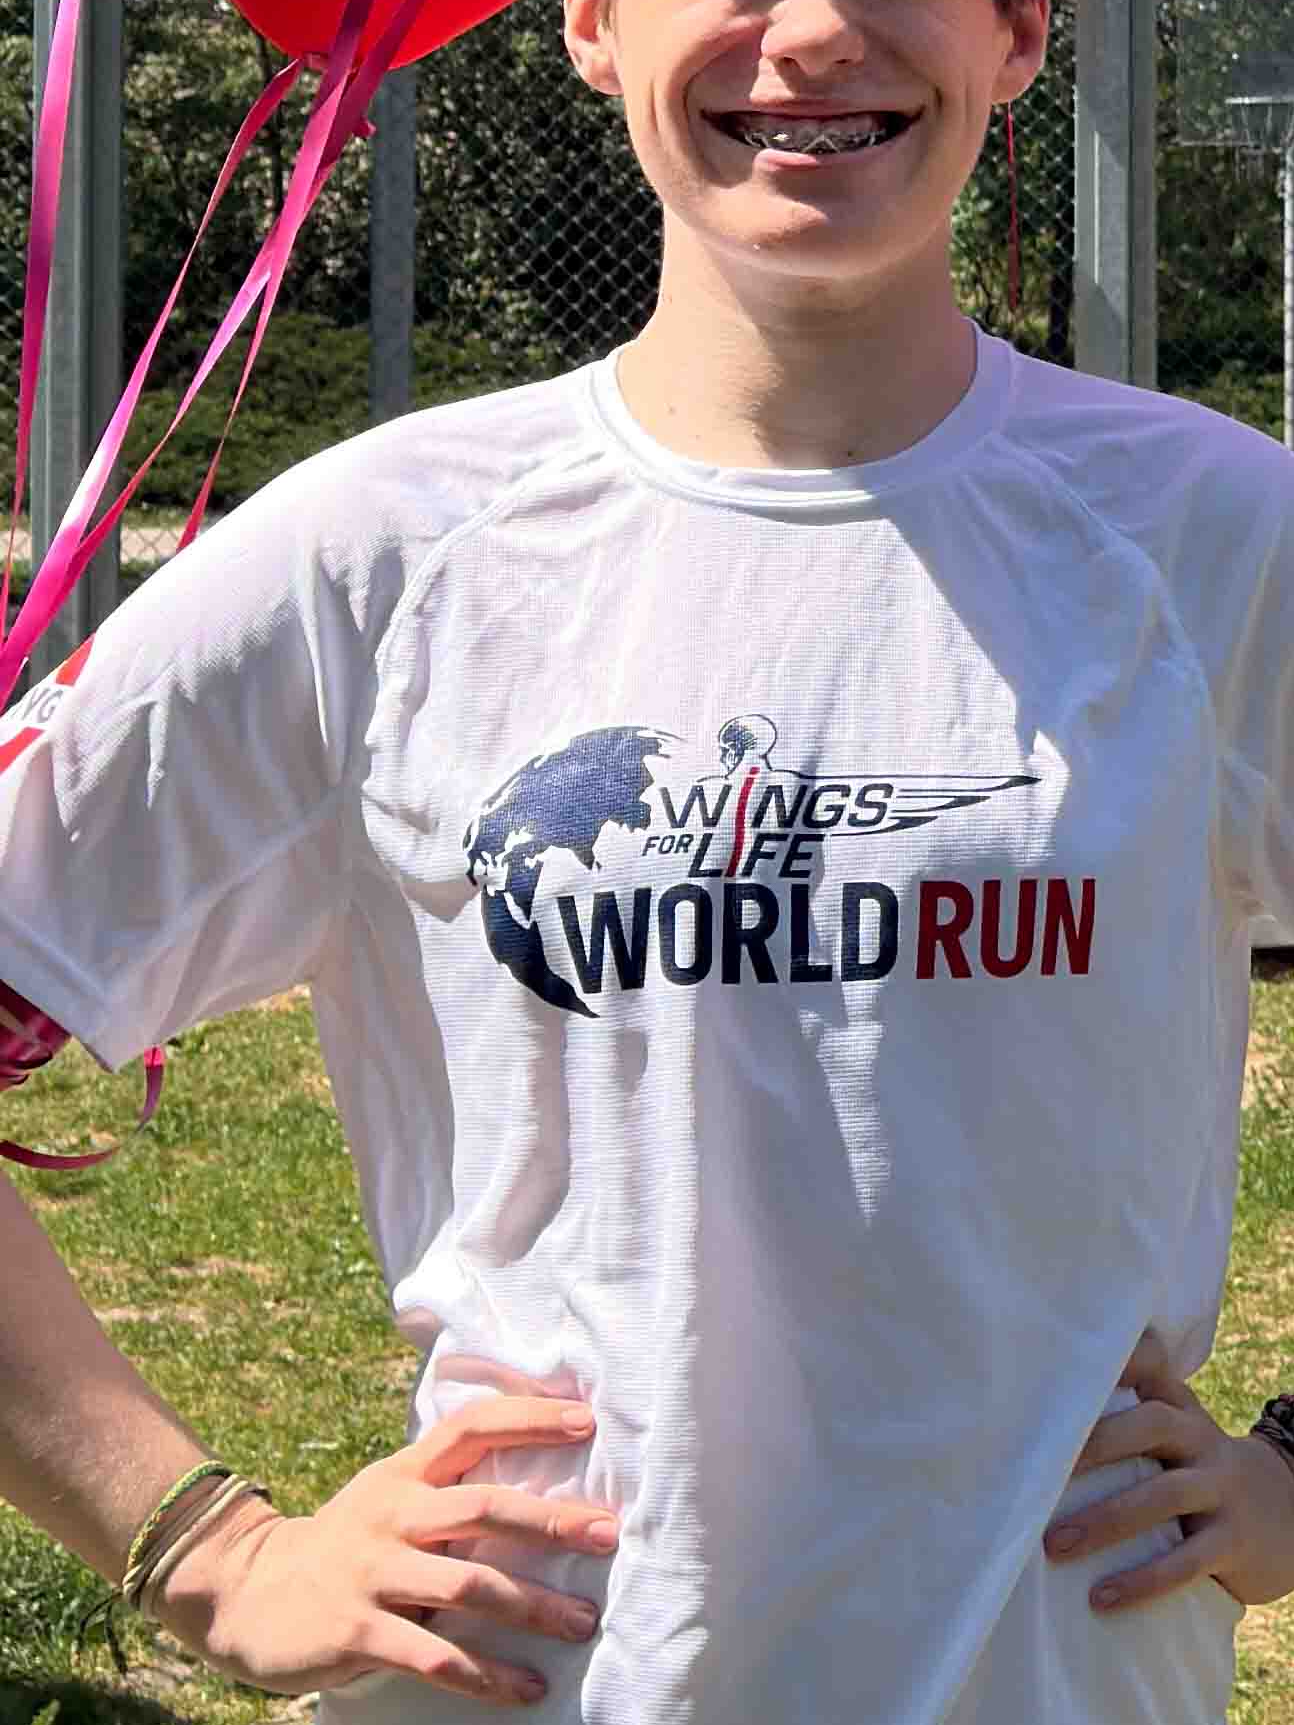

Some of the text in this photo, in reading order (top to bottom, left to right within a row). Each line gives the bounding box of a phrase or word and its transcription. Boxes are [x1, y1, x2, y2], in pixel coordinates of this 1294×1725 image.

[659, 767, 894, 831] WINGS
[642, 832, 826, 879] FOR LIFE
[556, 878, 1097, 994] WORLD RUN
